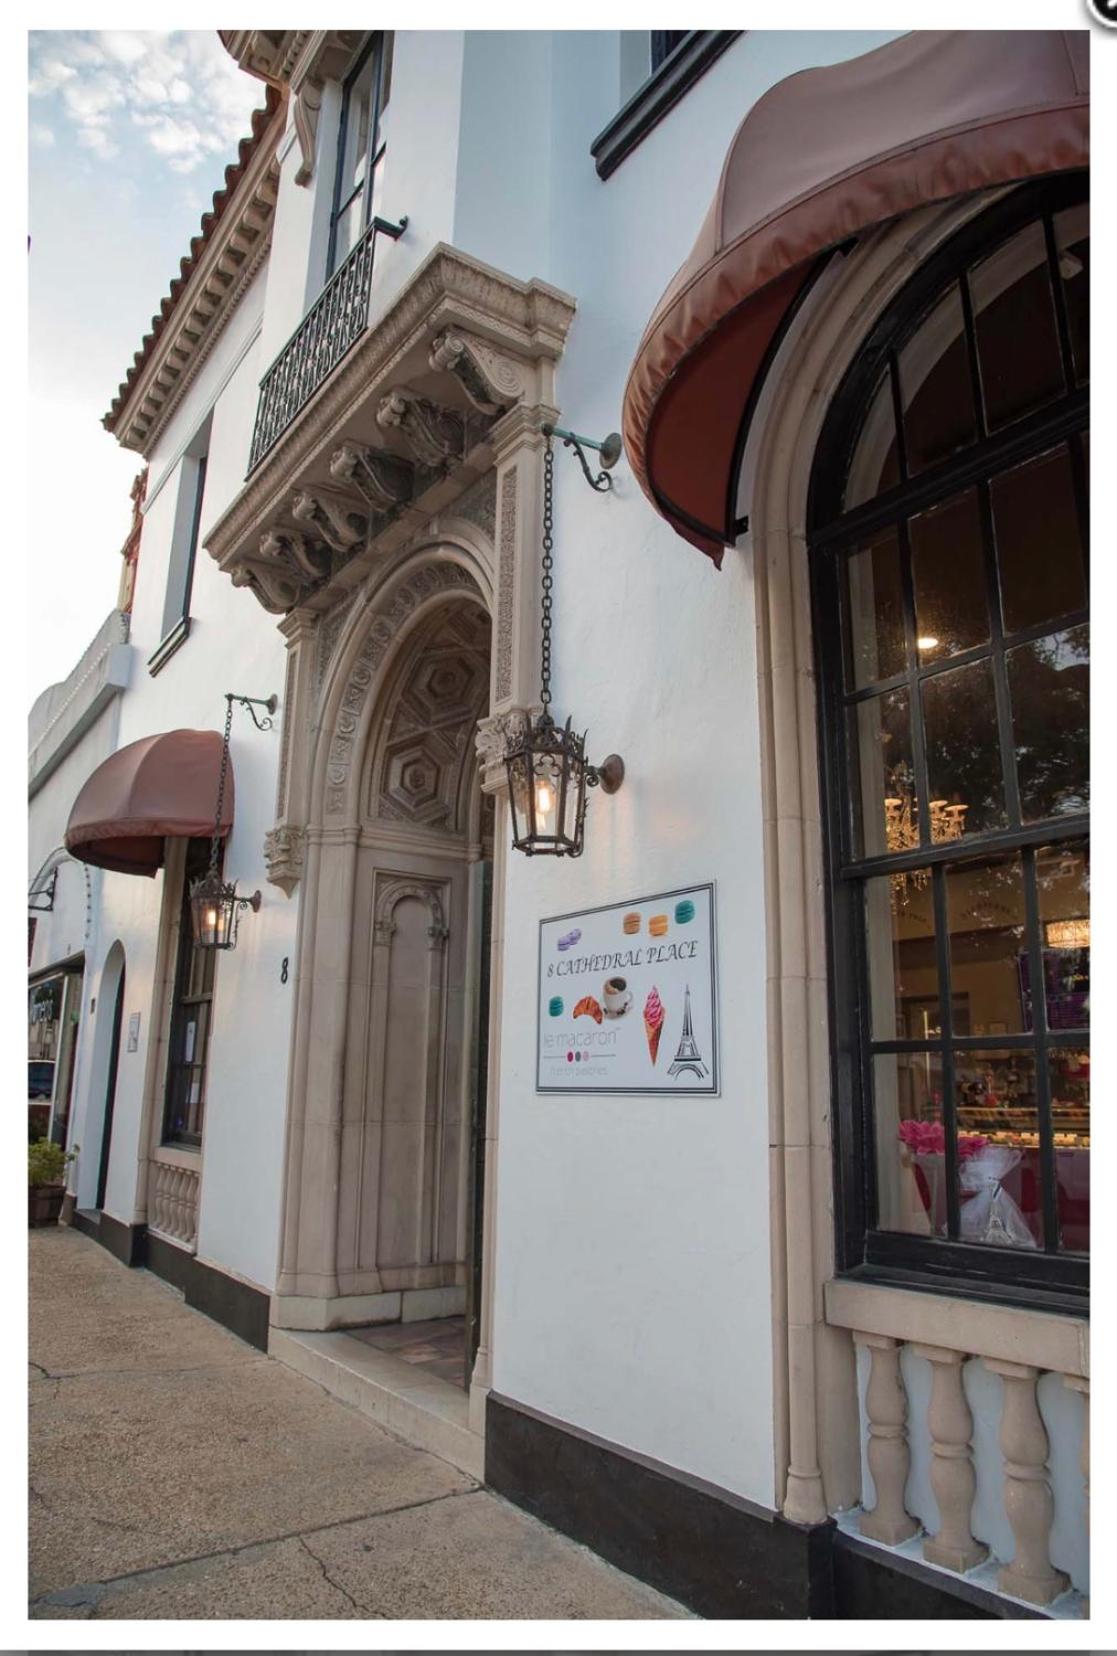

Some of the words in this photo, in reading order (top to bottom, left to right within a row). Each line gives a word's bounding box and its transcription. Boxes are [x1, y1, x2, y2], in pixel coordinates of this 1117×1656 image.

[281, 956, 289, 984] 8
[547, 963, 554, 978] 8
[556, 948, 643, 977] CATHEDRAL
[646, 940, 699, 964] PLACE
[556, 1031, 617, 1048] macaron
